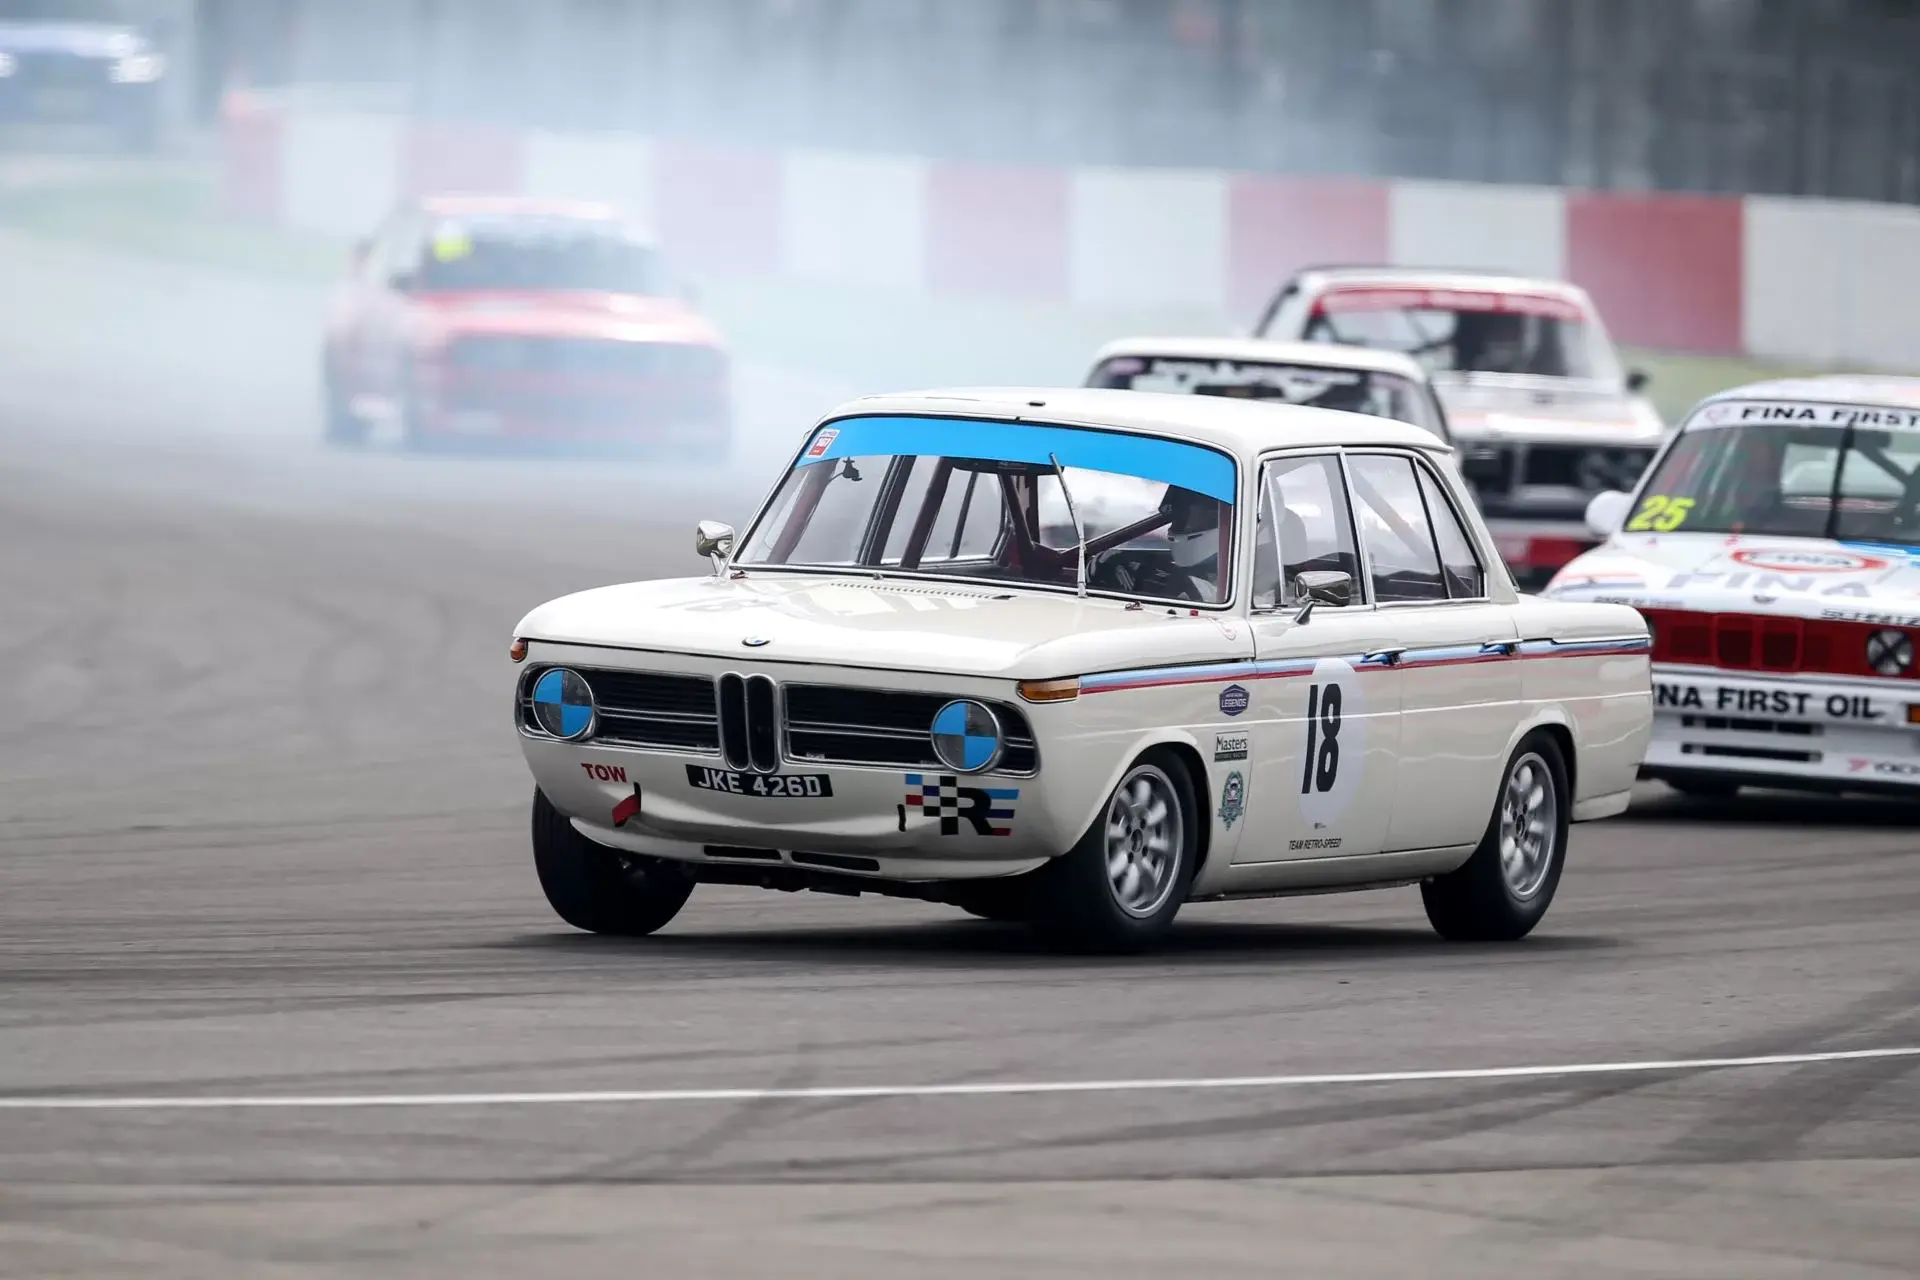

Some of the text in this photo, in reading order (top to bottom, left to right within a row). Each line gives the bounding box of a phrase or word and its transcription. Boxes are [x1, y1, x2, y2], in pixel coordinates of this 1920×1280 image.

[1741, 407, 1816, 421] FINA
[1627, 494, 1696, 532] 25
[1716, 686, 1813, 716] FIRST
[1825, 694, 1882, 719] OIL
[1215, 735, 1248, 752] Masters
[1301, 683, 1342, 794] 18
[580, 762, 628, 784] TOW
[697, 767, 822, 797] JKE 426D
[1288, 839, 1304, 851] TEAM
